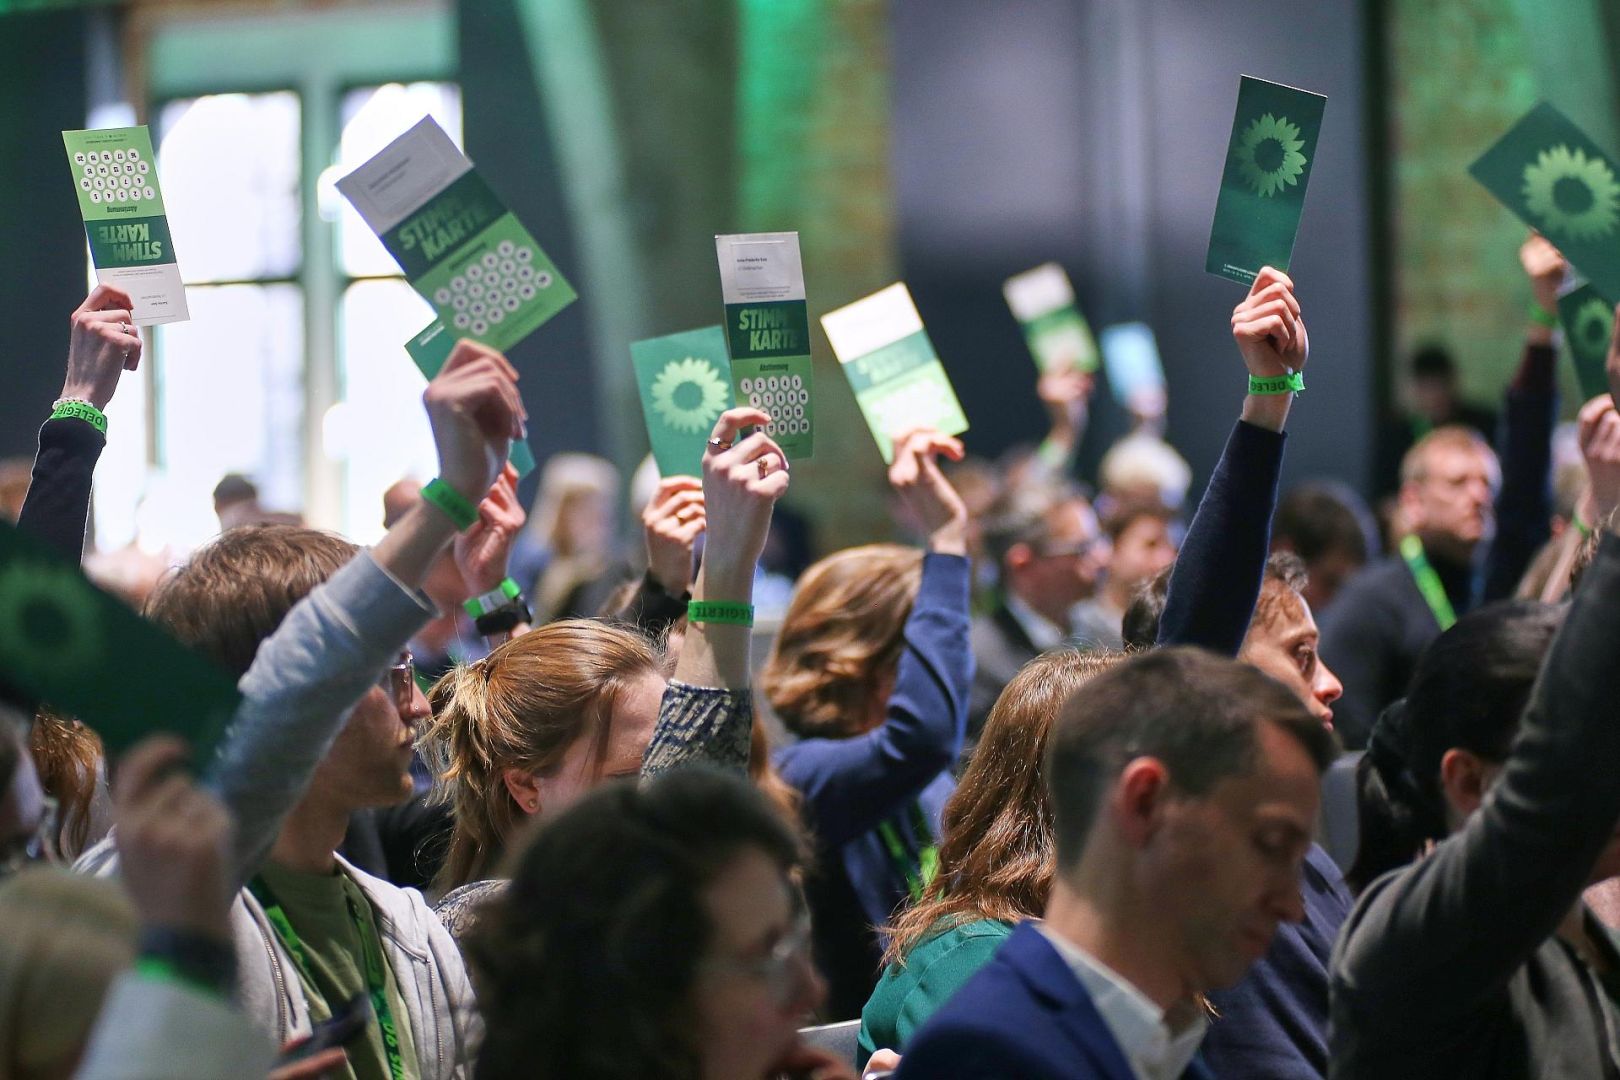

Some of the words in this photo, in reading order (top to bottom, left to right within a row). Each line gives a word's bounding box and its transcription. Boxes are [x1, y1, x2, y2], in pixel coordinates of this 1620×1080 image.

[99, 223, 149, 243] KARTE
[113, 241, 162, 261] STIMM
[750, 329, 799, 351] KARTE
